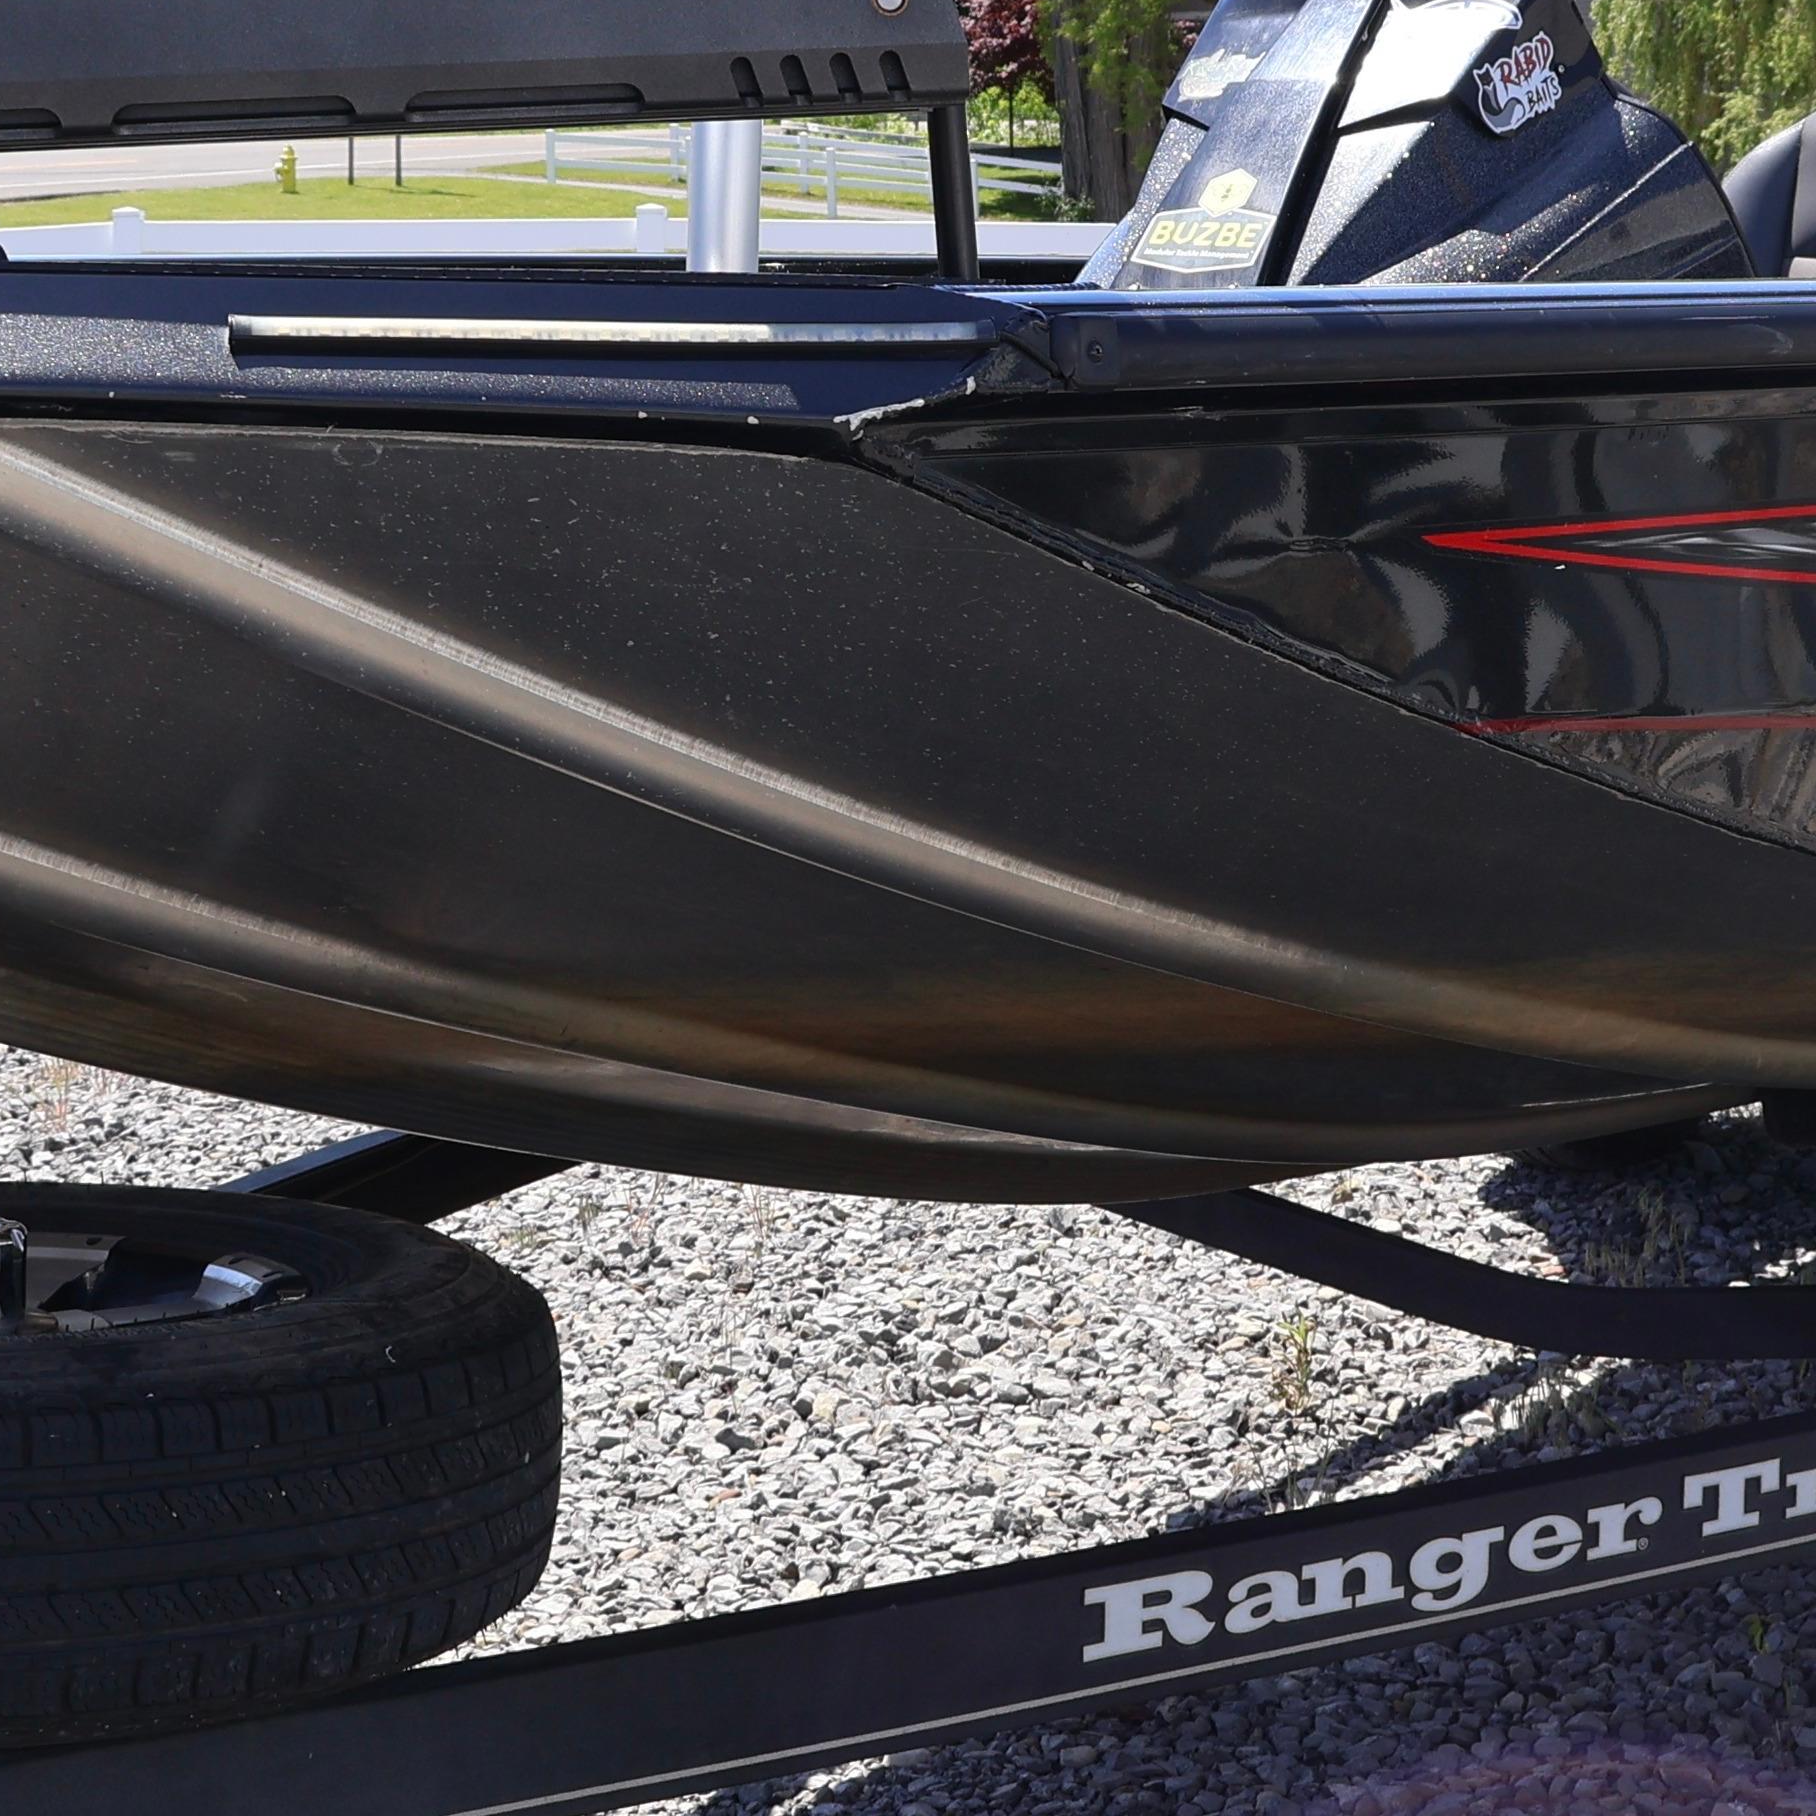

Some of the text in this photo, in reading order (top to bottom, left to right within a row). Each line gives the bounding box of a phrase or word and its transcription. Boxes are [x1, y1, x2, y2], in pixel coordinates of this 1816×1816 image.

[1493, 37, 1550, 96] RABID
[1525, 74, 1560, 114] BAITS
[1148, 220, 1263, 249] BUZBE
[1081, 1493, 1665, 1664] Ranger
